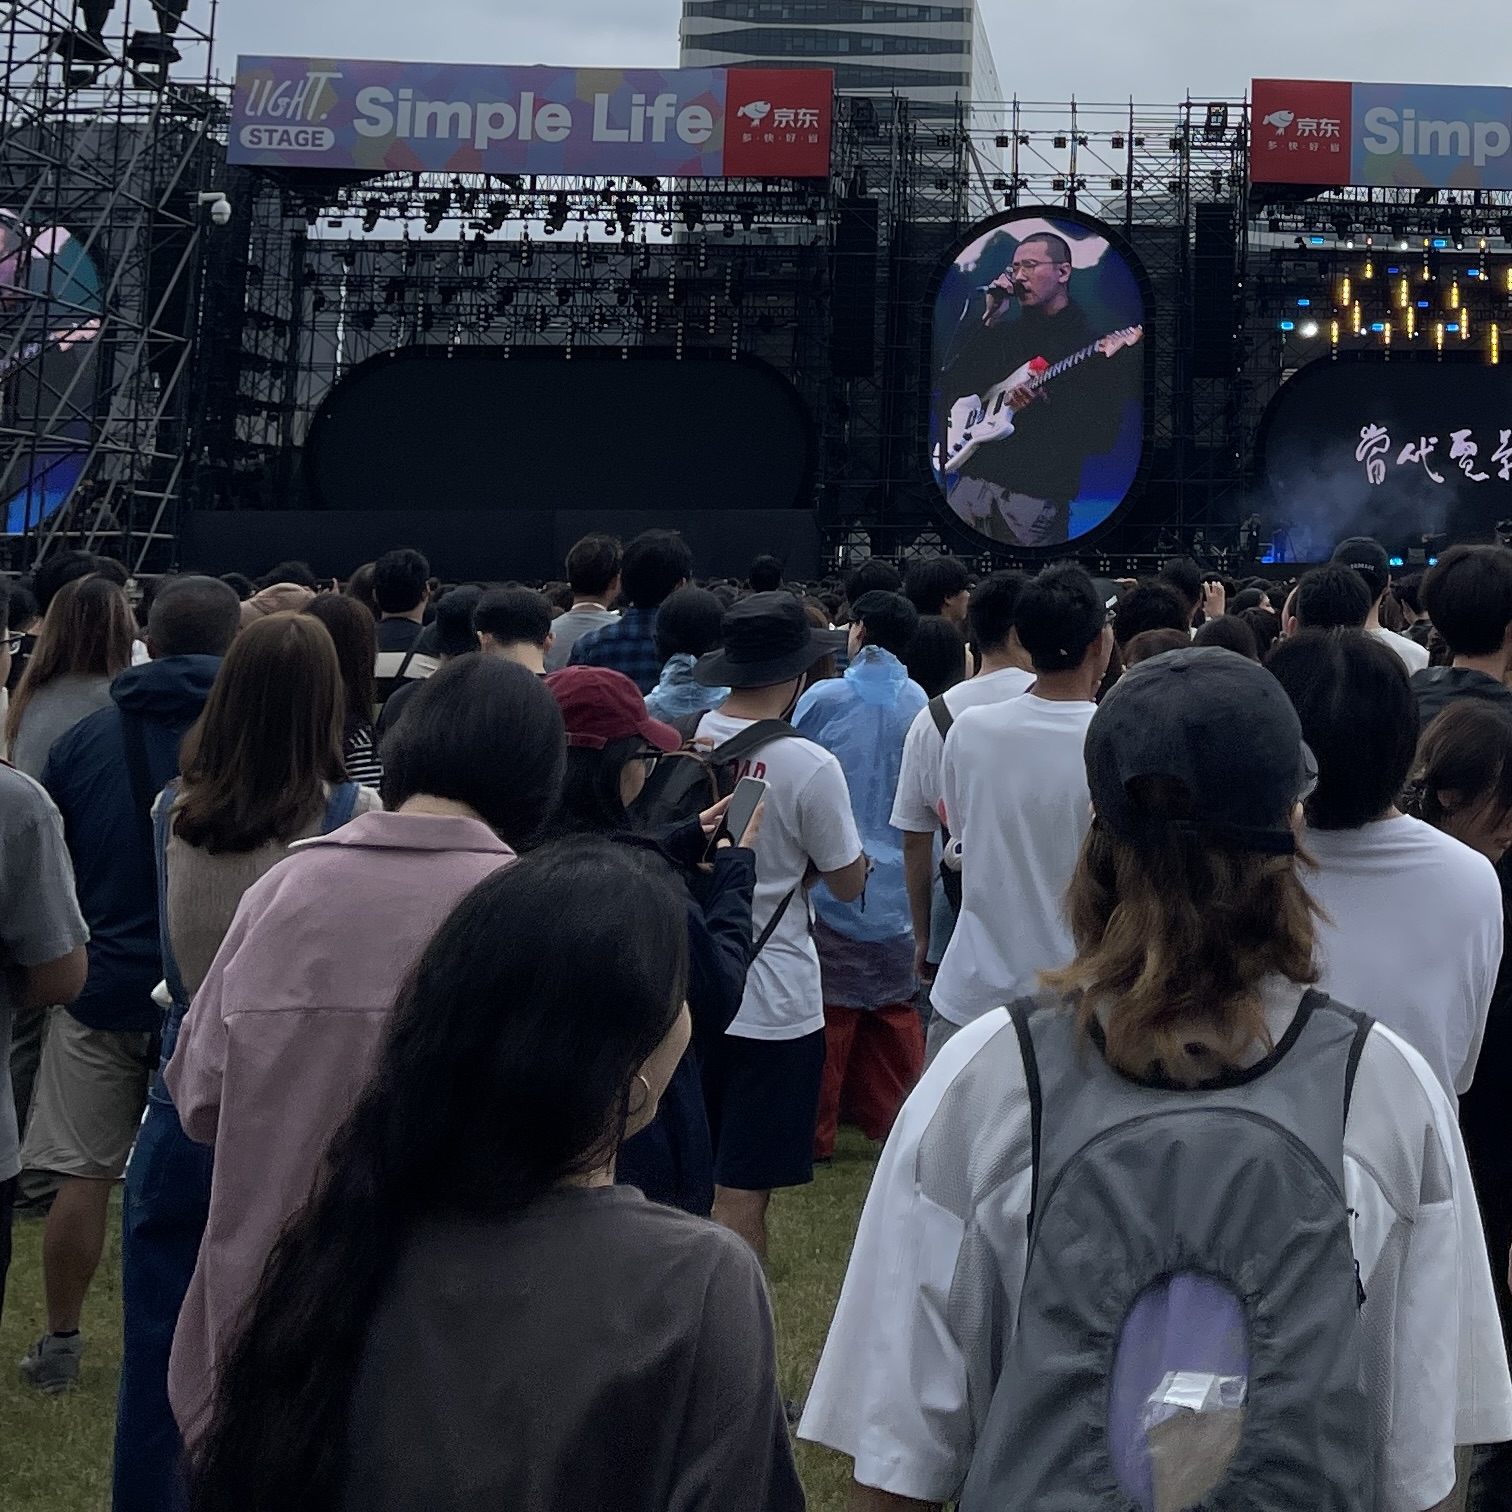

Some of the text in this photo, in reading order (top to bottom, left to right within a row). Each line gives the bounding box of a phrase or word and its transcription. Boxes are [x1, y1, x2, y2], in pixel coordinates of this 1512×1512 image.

[353, 86, 714, 150] Simple Life
[773, 108, 820, 128] 京东
[1296, 117, 1341, 138] 京东
[248, 128, 325, 148] STAGE
